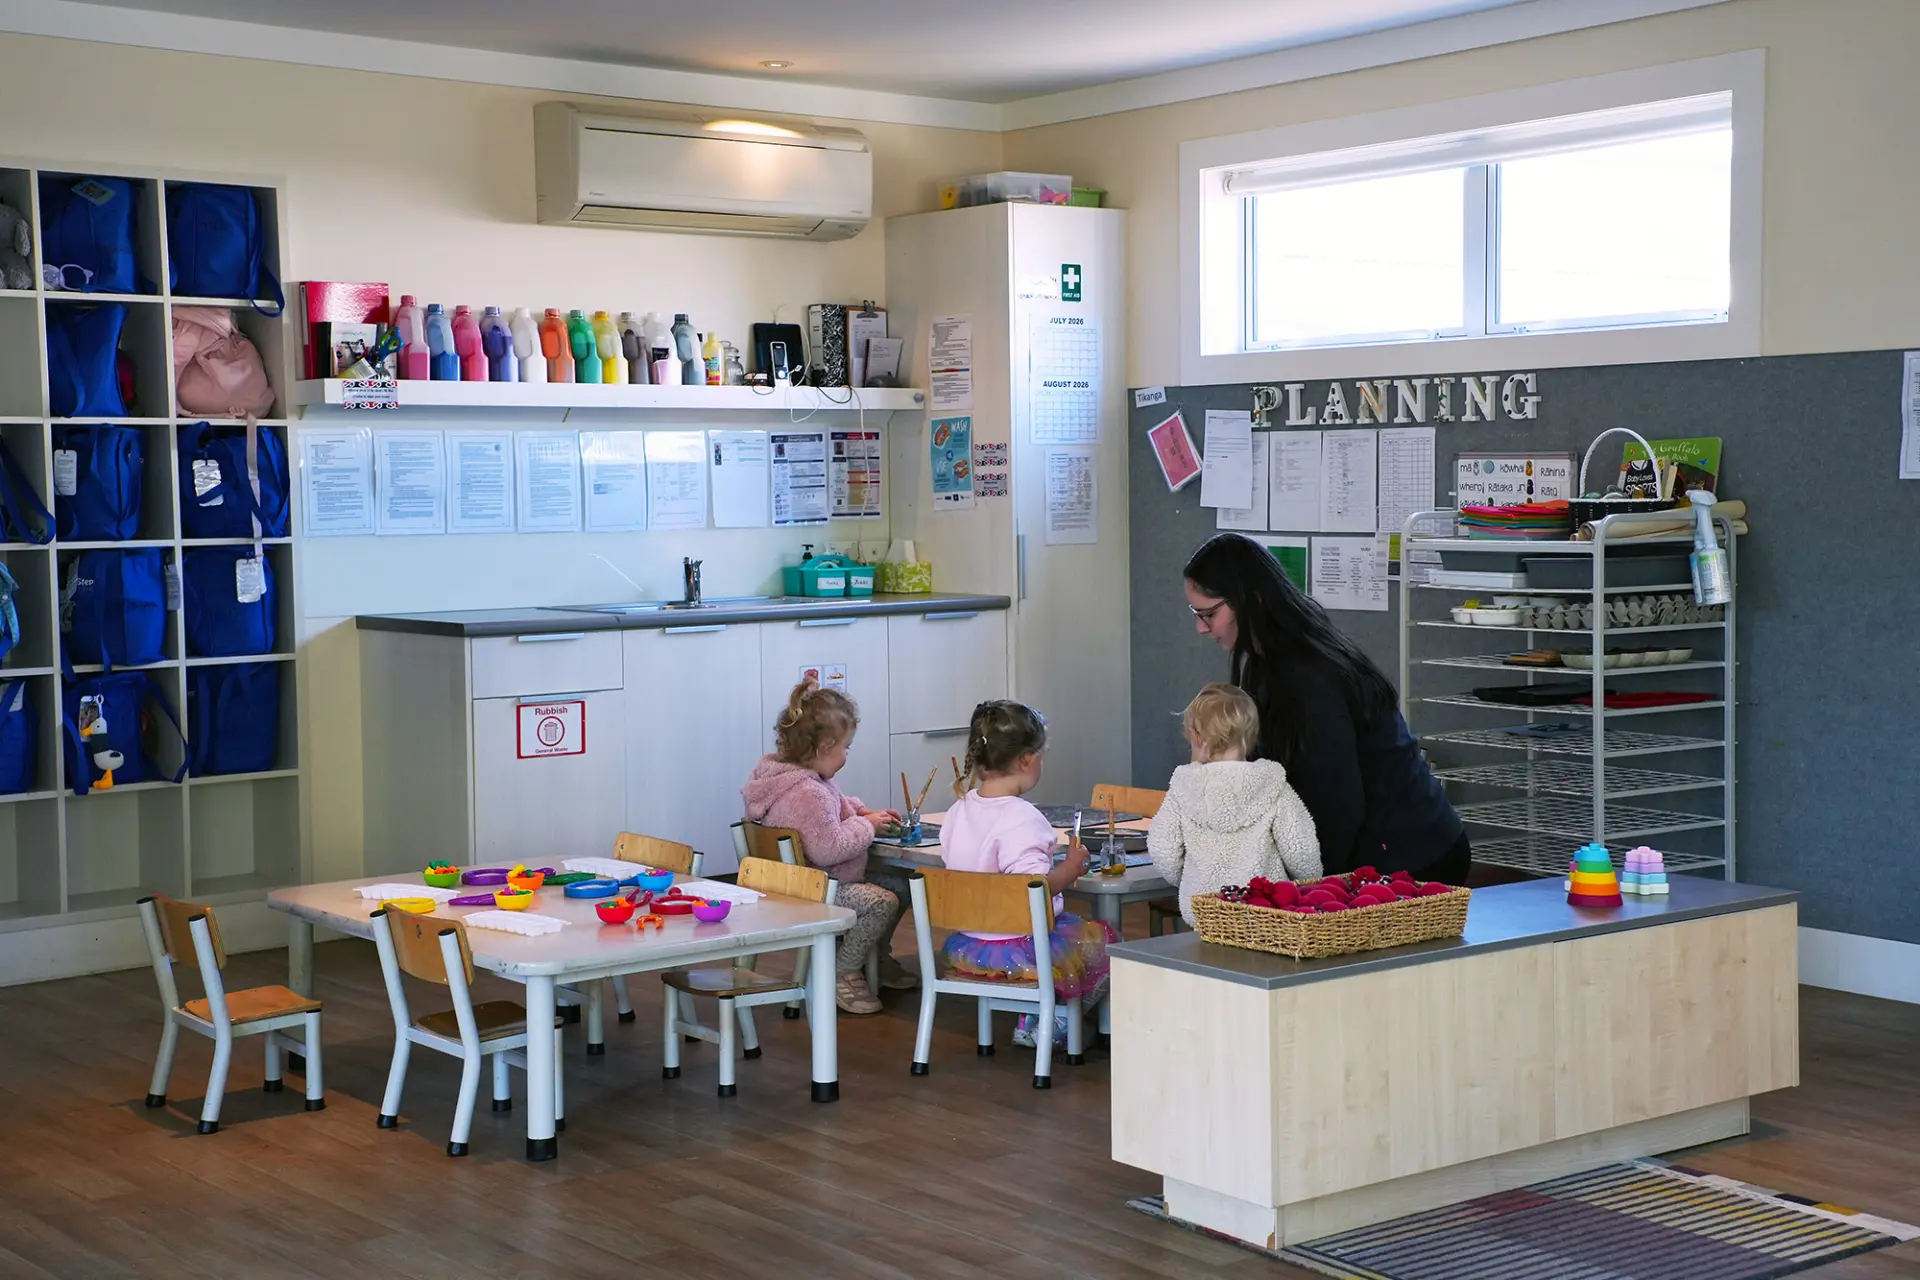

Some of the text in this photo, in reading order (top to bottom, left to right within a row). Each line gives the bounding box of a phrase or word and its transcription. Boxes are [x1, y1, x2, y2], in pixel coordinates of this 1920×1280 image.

[1137, 391, 1163, 402] Tikanga
[1250, 373, 1542, 427] PLANNING
[951, 420, 968, 433] WASH
[1660, 442, 1700, 455] Gruffalo
[1460, 463, 1472, 472] mā
[1540, 467, 1566, 476] Rāhina
[1627, 475, 1639, 483] Baby
[1459, 483, 1482, 491] whero
[1541, 487, 1558, 496] Rātū
[1625, 482, 1657, 495] SPRTS
[535, 707, 568, 715] Rubbish
